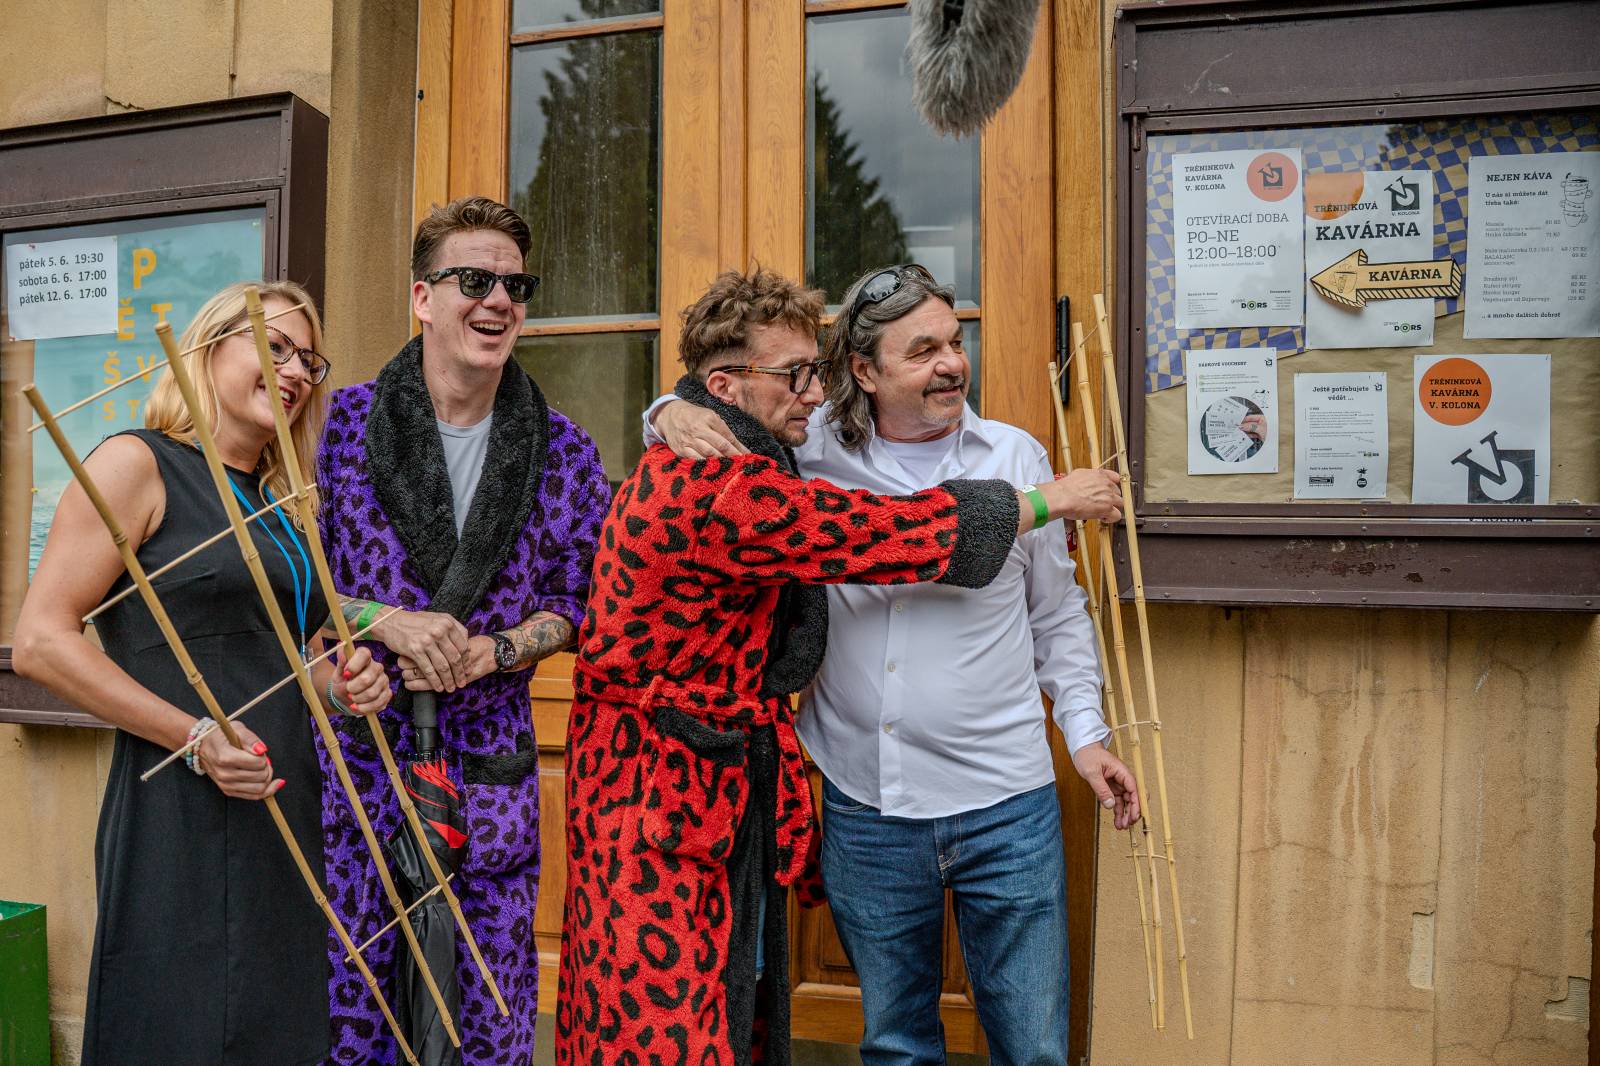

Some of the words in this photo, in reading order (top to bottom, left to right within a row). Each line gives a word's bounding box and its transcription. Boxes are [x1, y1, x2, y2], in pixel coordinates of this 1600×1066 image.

[1184, 163, 1236, 173] TRÉNINKOVÁ
[1185, 174, 1223, 182] KAVÁRNA
[1486, 173, 1521, 182] NEJEN
[1195, 183, 1226, 191] KOLONA
[1314, 201, 1378, 213] TRÉNINKOVÁ
[1186, 211, 1253, 227] OTEVÍRACÍ
[1257, 213, 1289, 223] DOBA
[1316, 221, 1421, 241] KAVÁRNA
[19, 256, 46, 271] pátek
[48, 256, 57, 267] 5.
[60, 255, 69, 265] 6.
[74, 252, 104, 264] 19:30
[18, 276, 48, 288] sobota
[51, 274, 61, 284] 6.
[63, 273, 73, 283] 6.
[78, 270, 107, 282] 17:00
[1369, 267, 1442, 282] KAVÁRNA
[19, 290, 45, 306] pátek
[47, 291, 61, 302] 12.
[64, 290, 73, 300] 6.
[79, 287, 107, 299] 17:00
[1429, 377, 1482, 385] TRÉNINKOVÁ
[1431, 387, 1480, 397] KAVÁRNA
[1441, 401, 1481, 409] KOLONA
